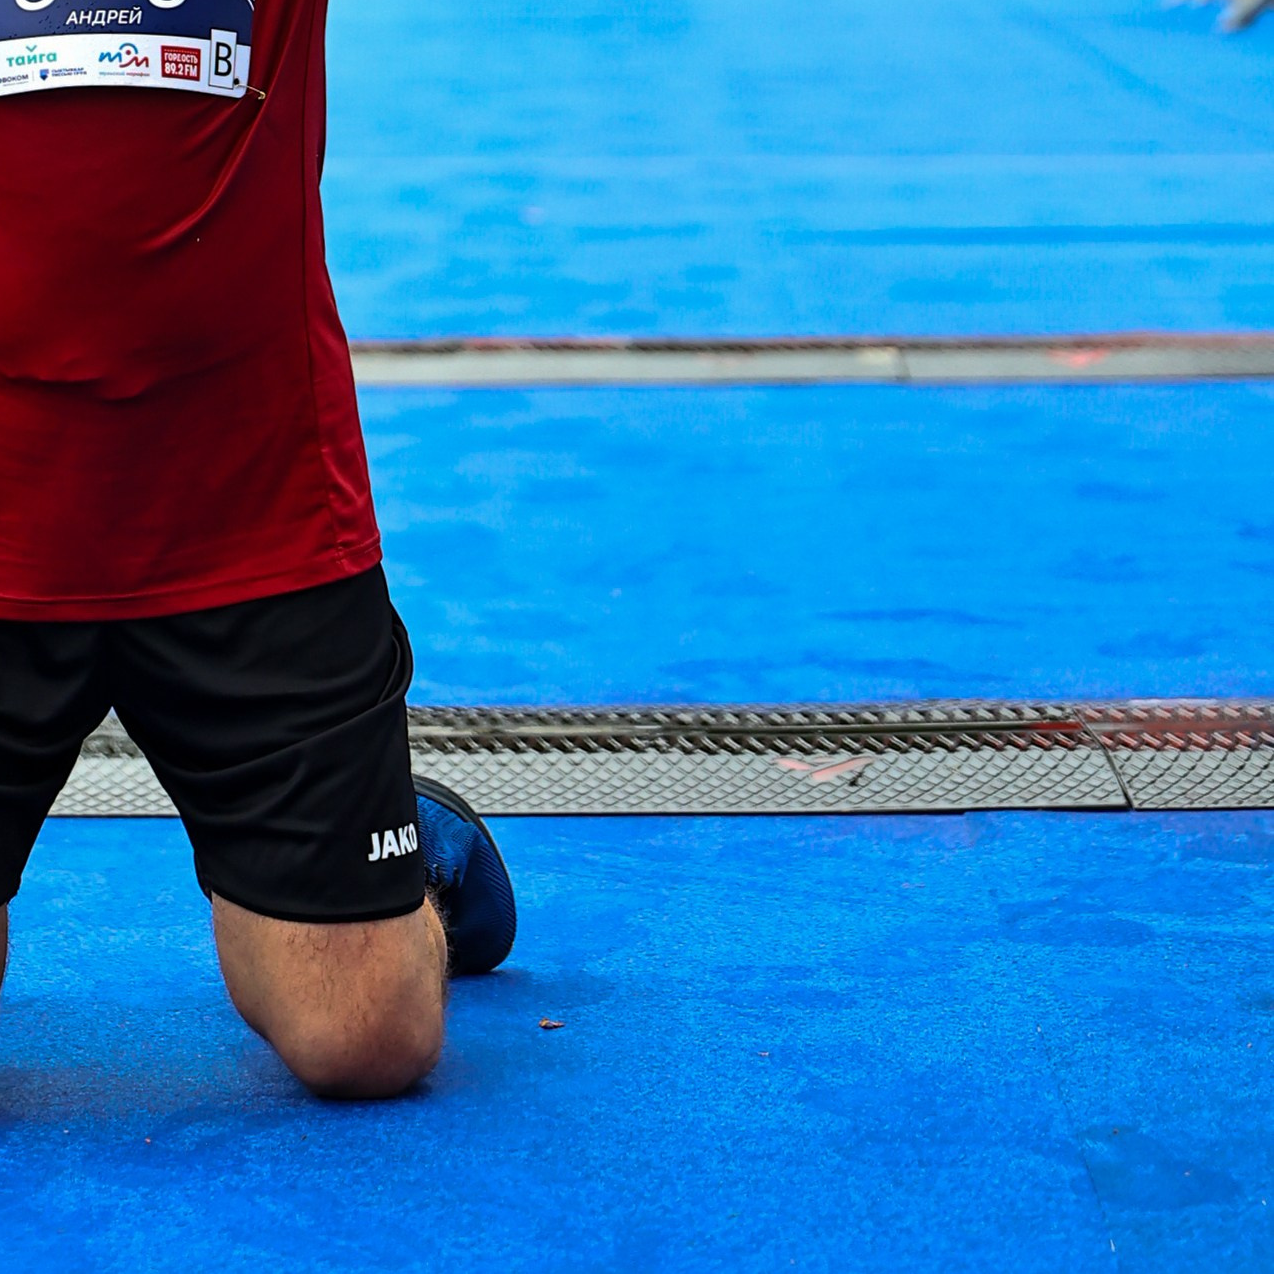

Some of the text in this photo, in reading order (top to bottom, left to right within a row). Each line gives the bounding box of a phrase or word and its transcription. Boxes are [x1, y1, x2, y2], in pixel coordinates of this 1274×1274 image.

[66, 7, 143, 26] АНДРЕЙ
[6, 44, 57, 67] тайга
[164, 62, 198, 77] 89.2 FM
[367, 822, 419, 862] JAKO
